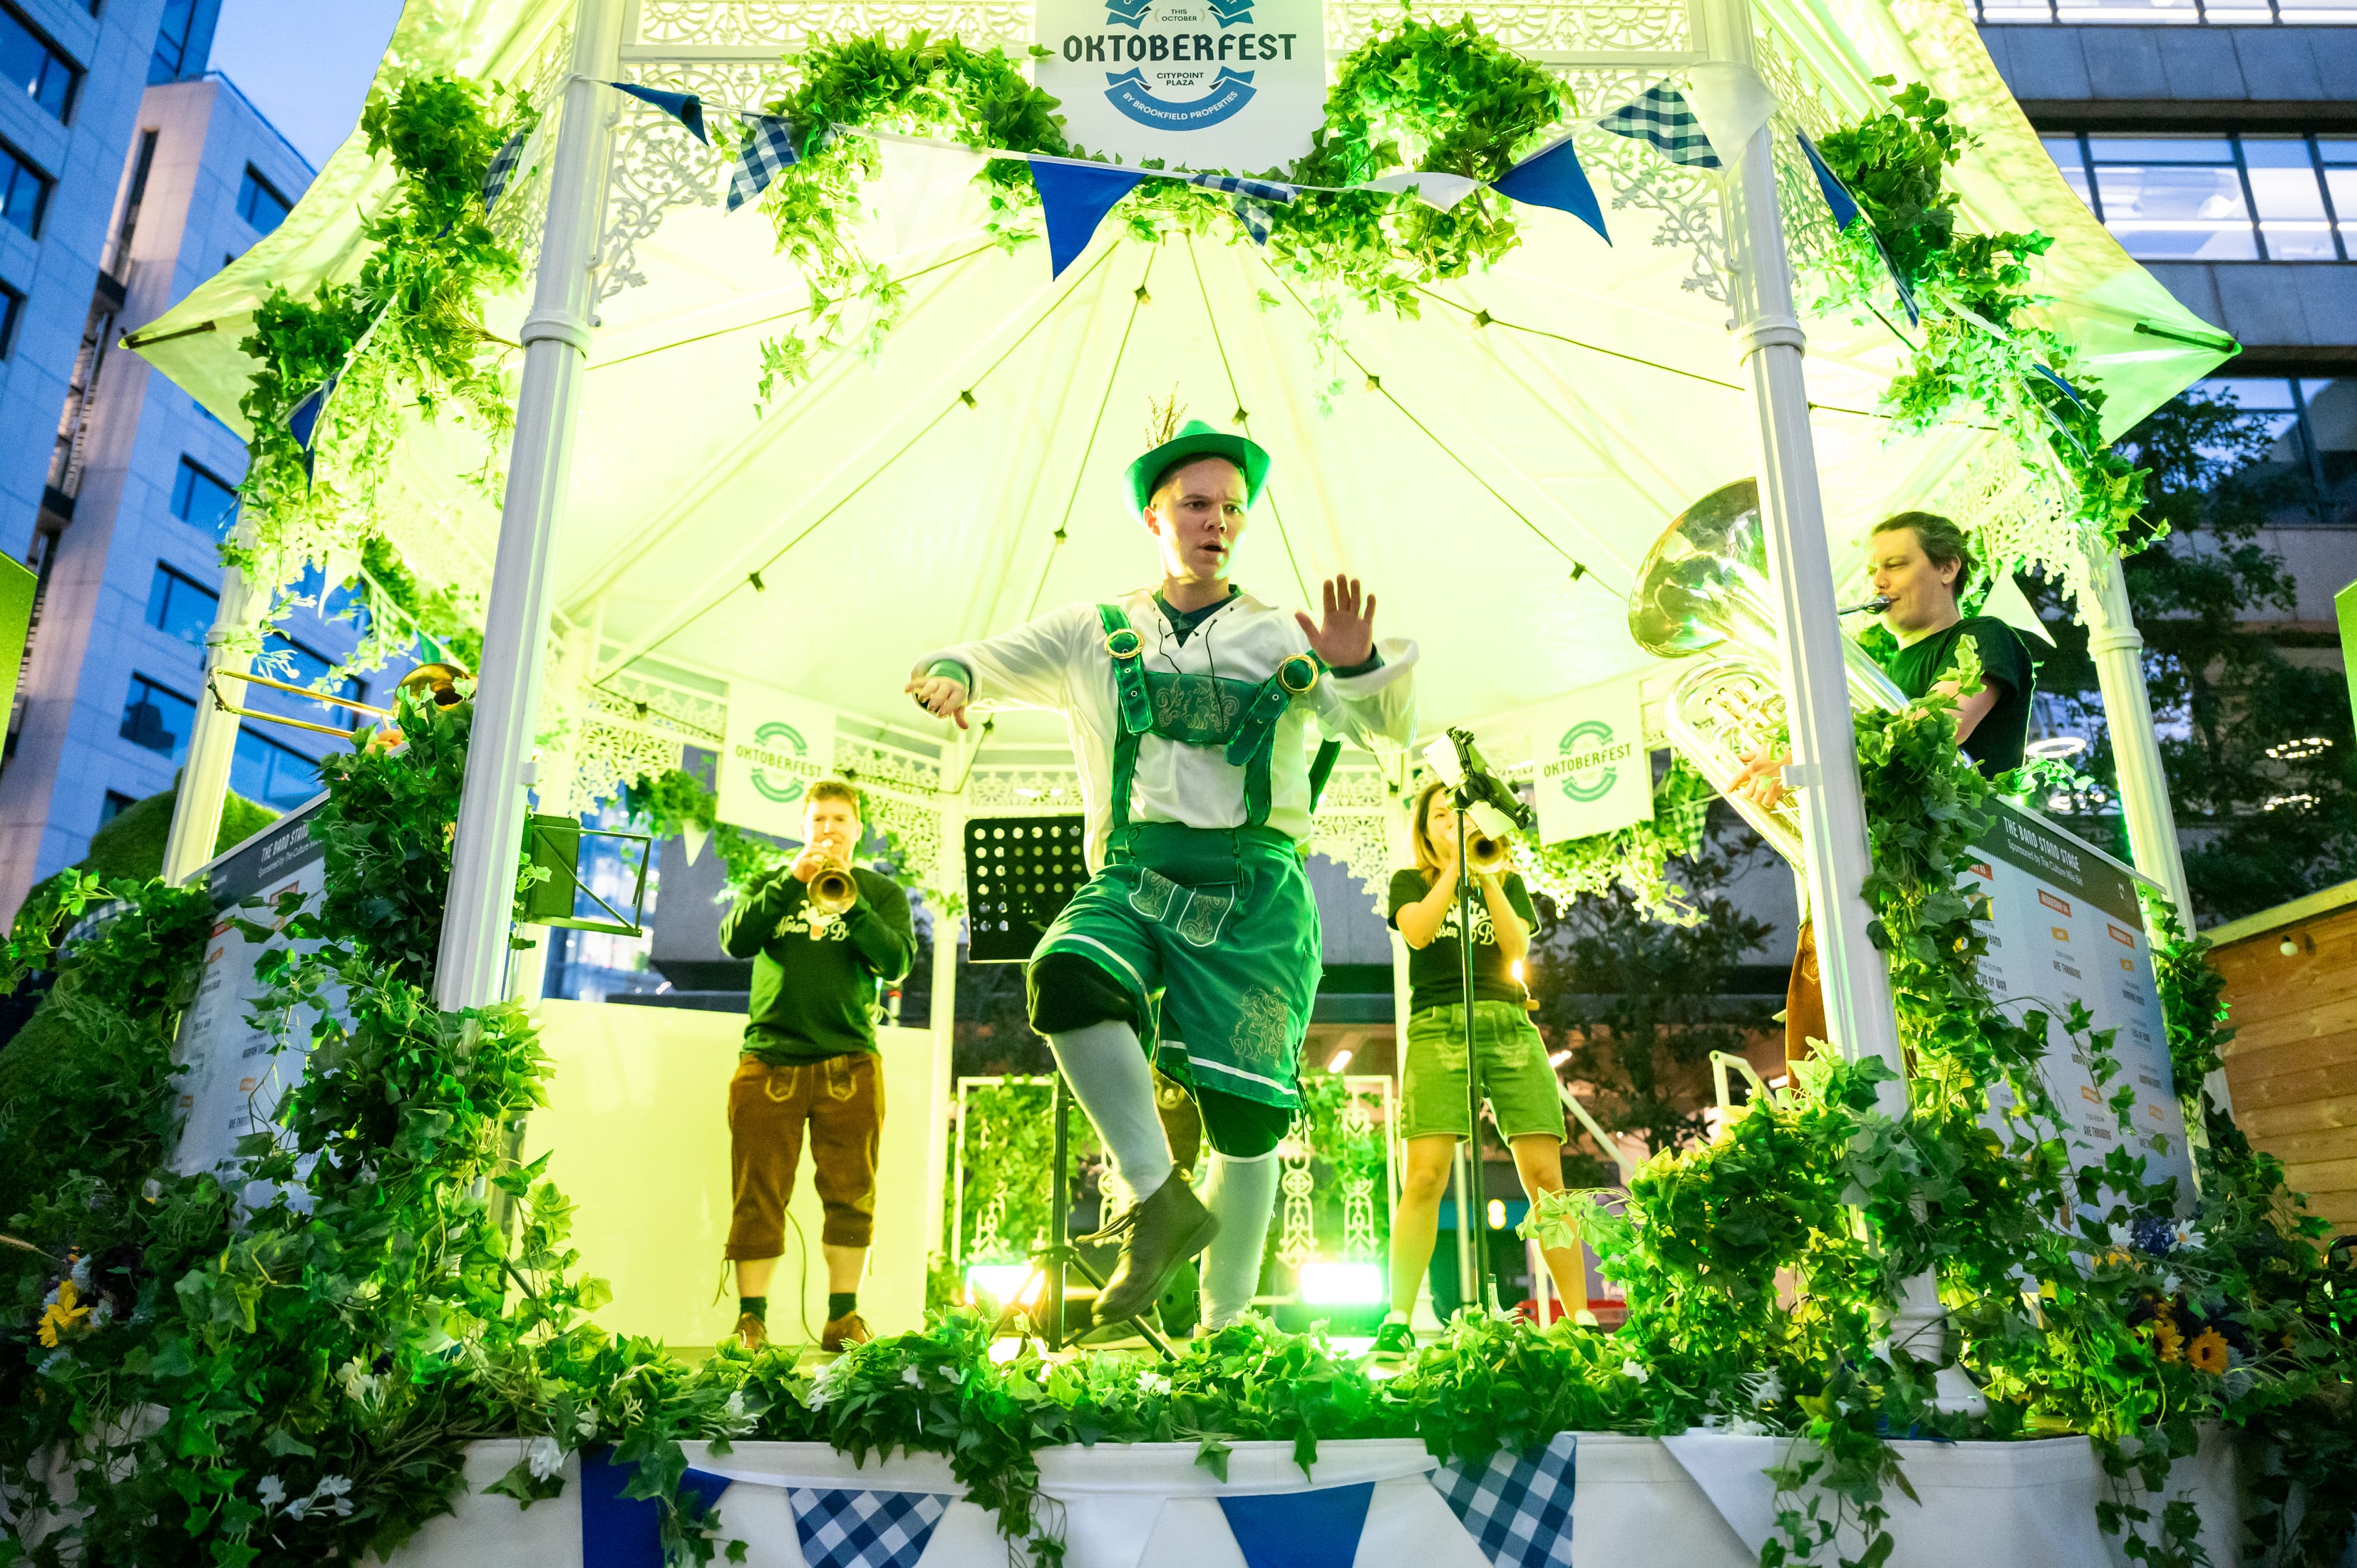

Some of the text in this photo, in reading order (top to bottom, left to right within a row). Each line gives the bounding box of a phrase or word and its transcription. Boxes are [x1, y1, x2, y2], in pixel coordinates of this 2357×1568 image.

[1063, 33, 1296, 63] OKTOBERFEST
[1123, 91, 1238, 120] BY BROOKFIELD PROPERTIES
[736, 744, 822, 778] OKTOBERFEST
[1544, 743, 1631, 778] OKTOBERFEST
[261, 842, 274, 863] THE
[273, 832, 289, 856] BAND
[2003, 816, 2080, 871] THE BAND STAND STAGE
[2007, 838, 2034, 860] Sponsored
[2033, 852, 2041, 867] by
[1979, 972, 2008, 991] TUG OF WAR
